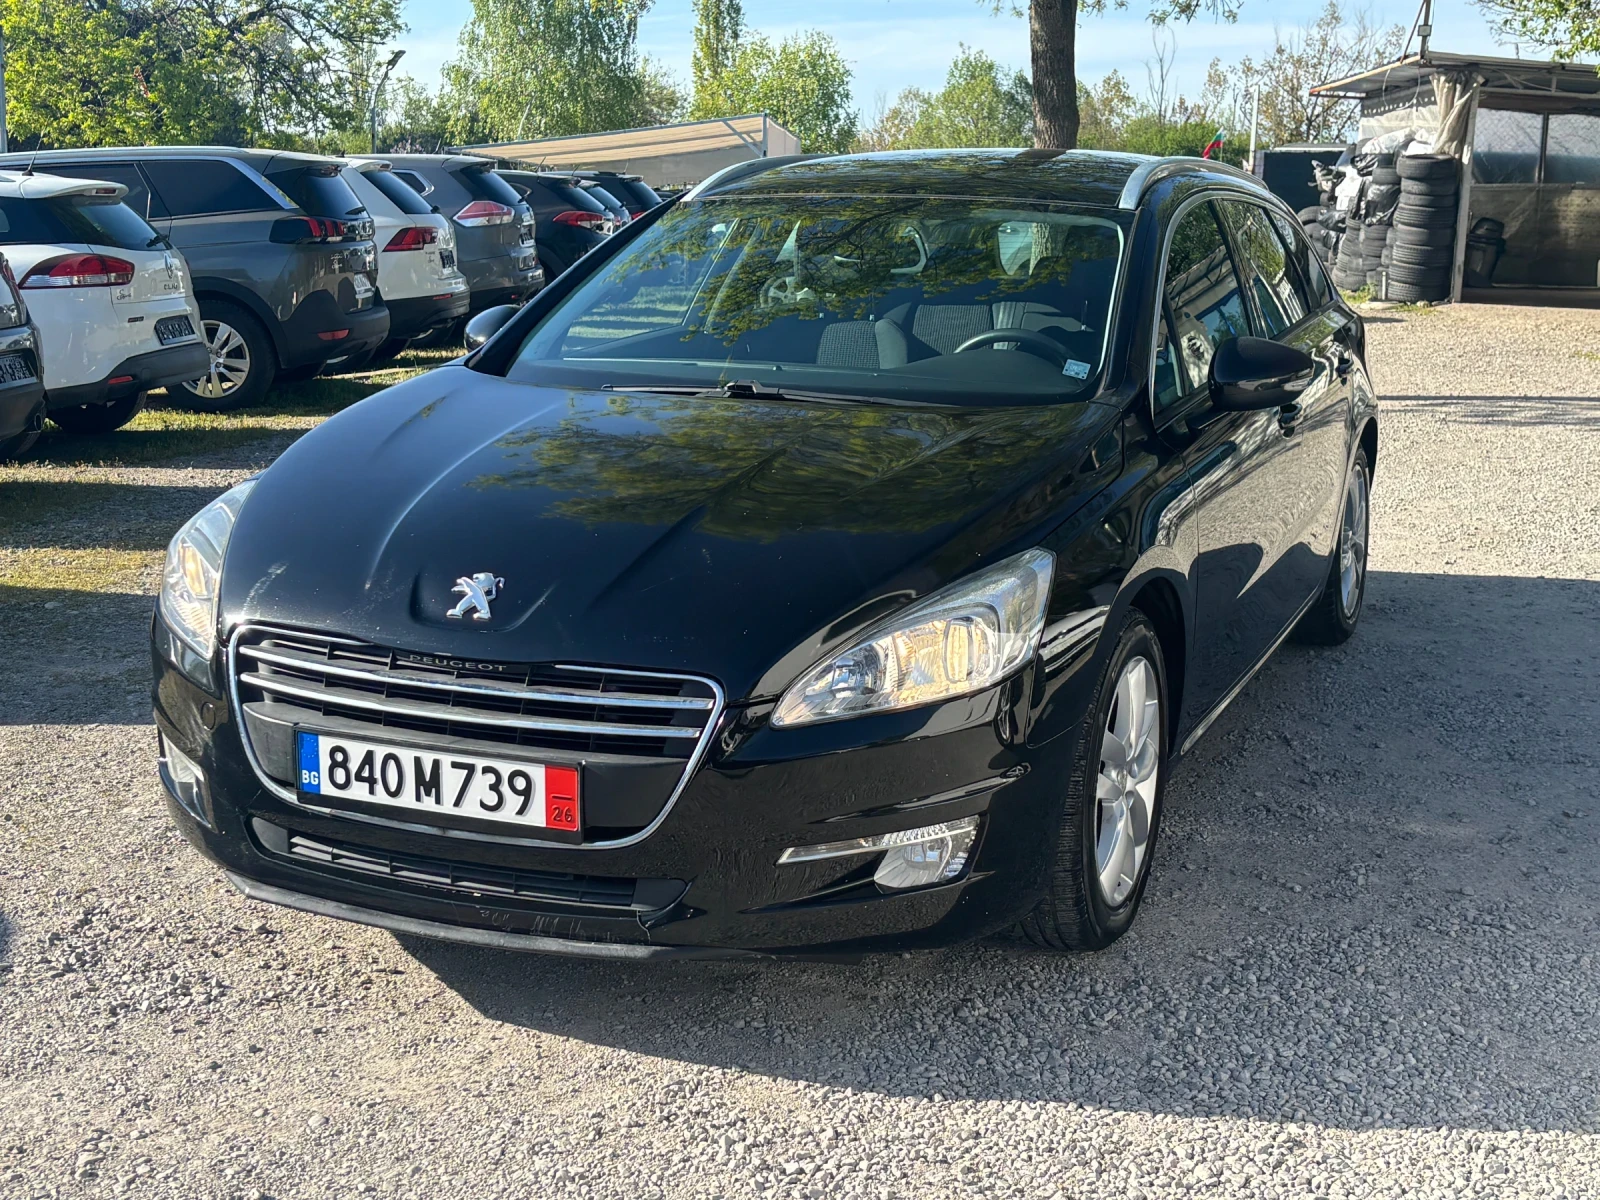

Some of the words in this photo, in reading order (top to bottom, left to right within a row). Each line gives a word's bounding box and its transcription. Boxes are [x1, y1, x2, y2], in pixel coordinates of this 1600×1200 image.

[409, 654, 507, 672] PEUGEOT
[301, 769, 319, 785] BG
[550, 805, 573, 823] 26
